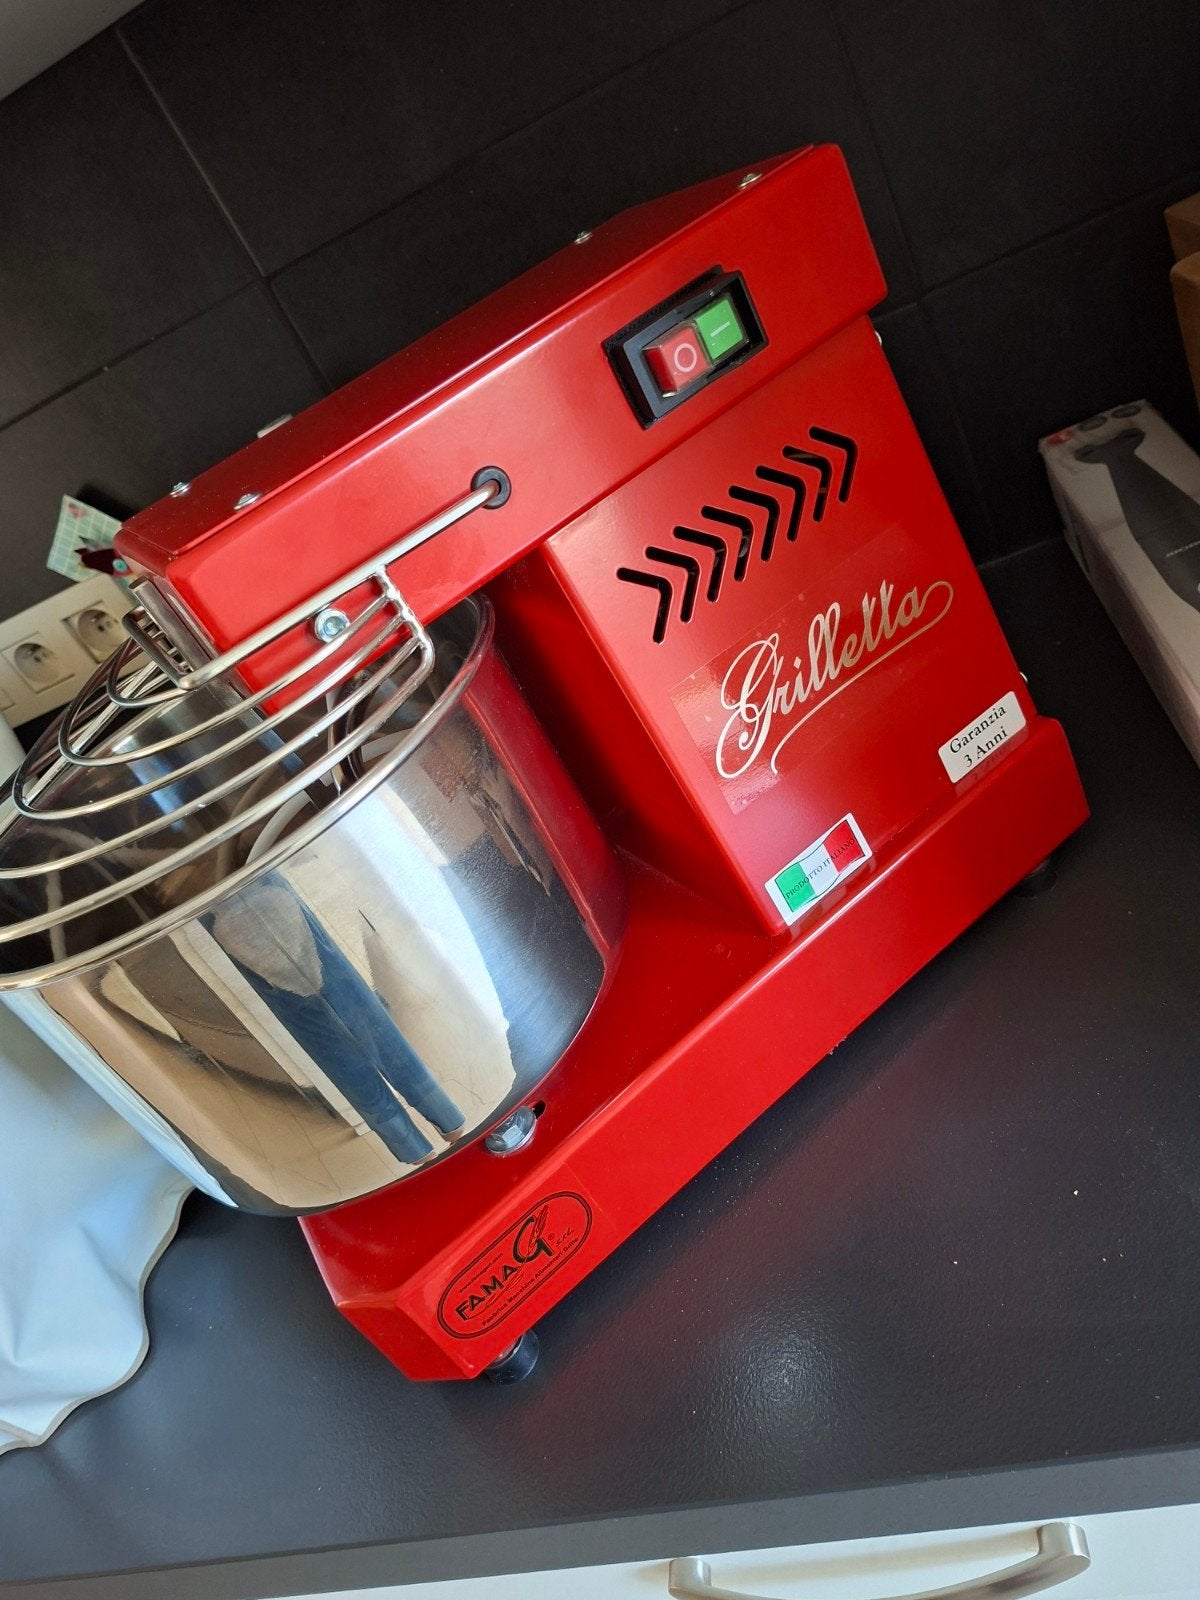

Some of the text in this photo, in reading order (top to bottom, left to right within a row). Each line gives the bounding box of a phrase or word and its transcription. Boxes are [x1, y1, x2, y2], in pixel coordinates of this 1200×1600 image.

[715, 579, 954, 779] Grilletta
[949, 705, 1007, 754] Garanzia
[963, 725, 1009, 768] 3 Anni
[785, 838, 856, 899] PRODOTTO ITALIANO
